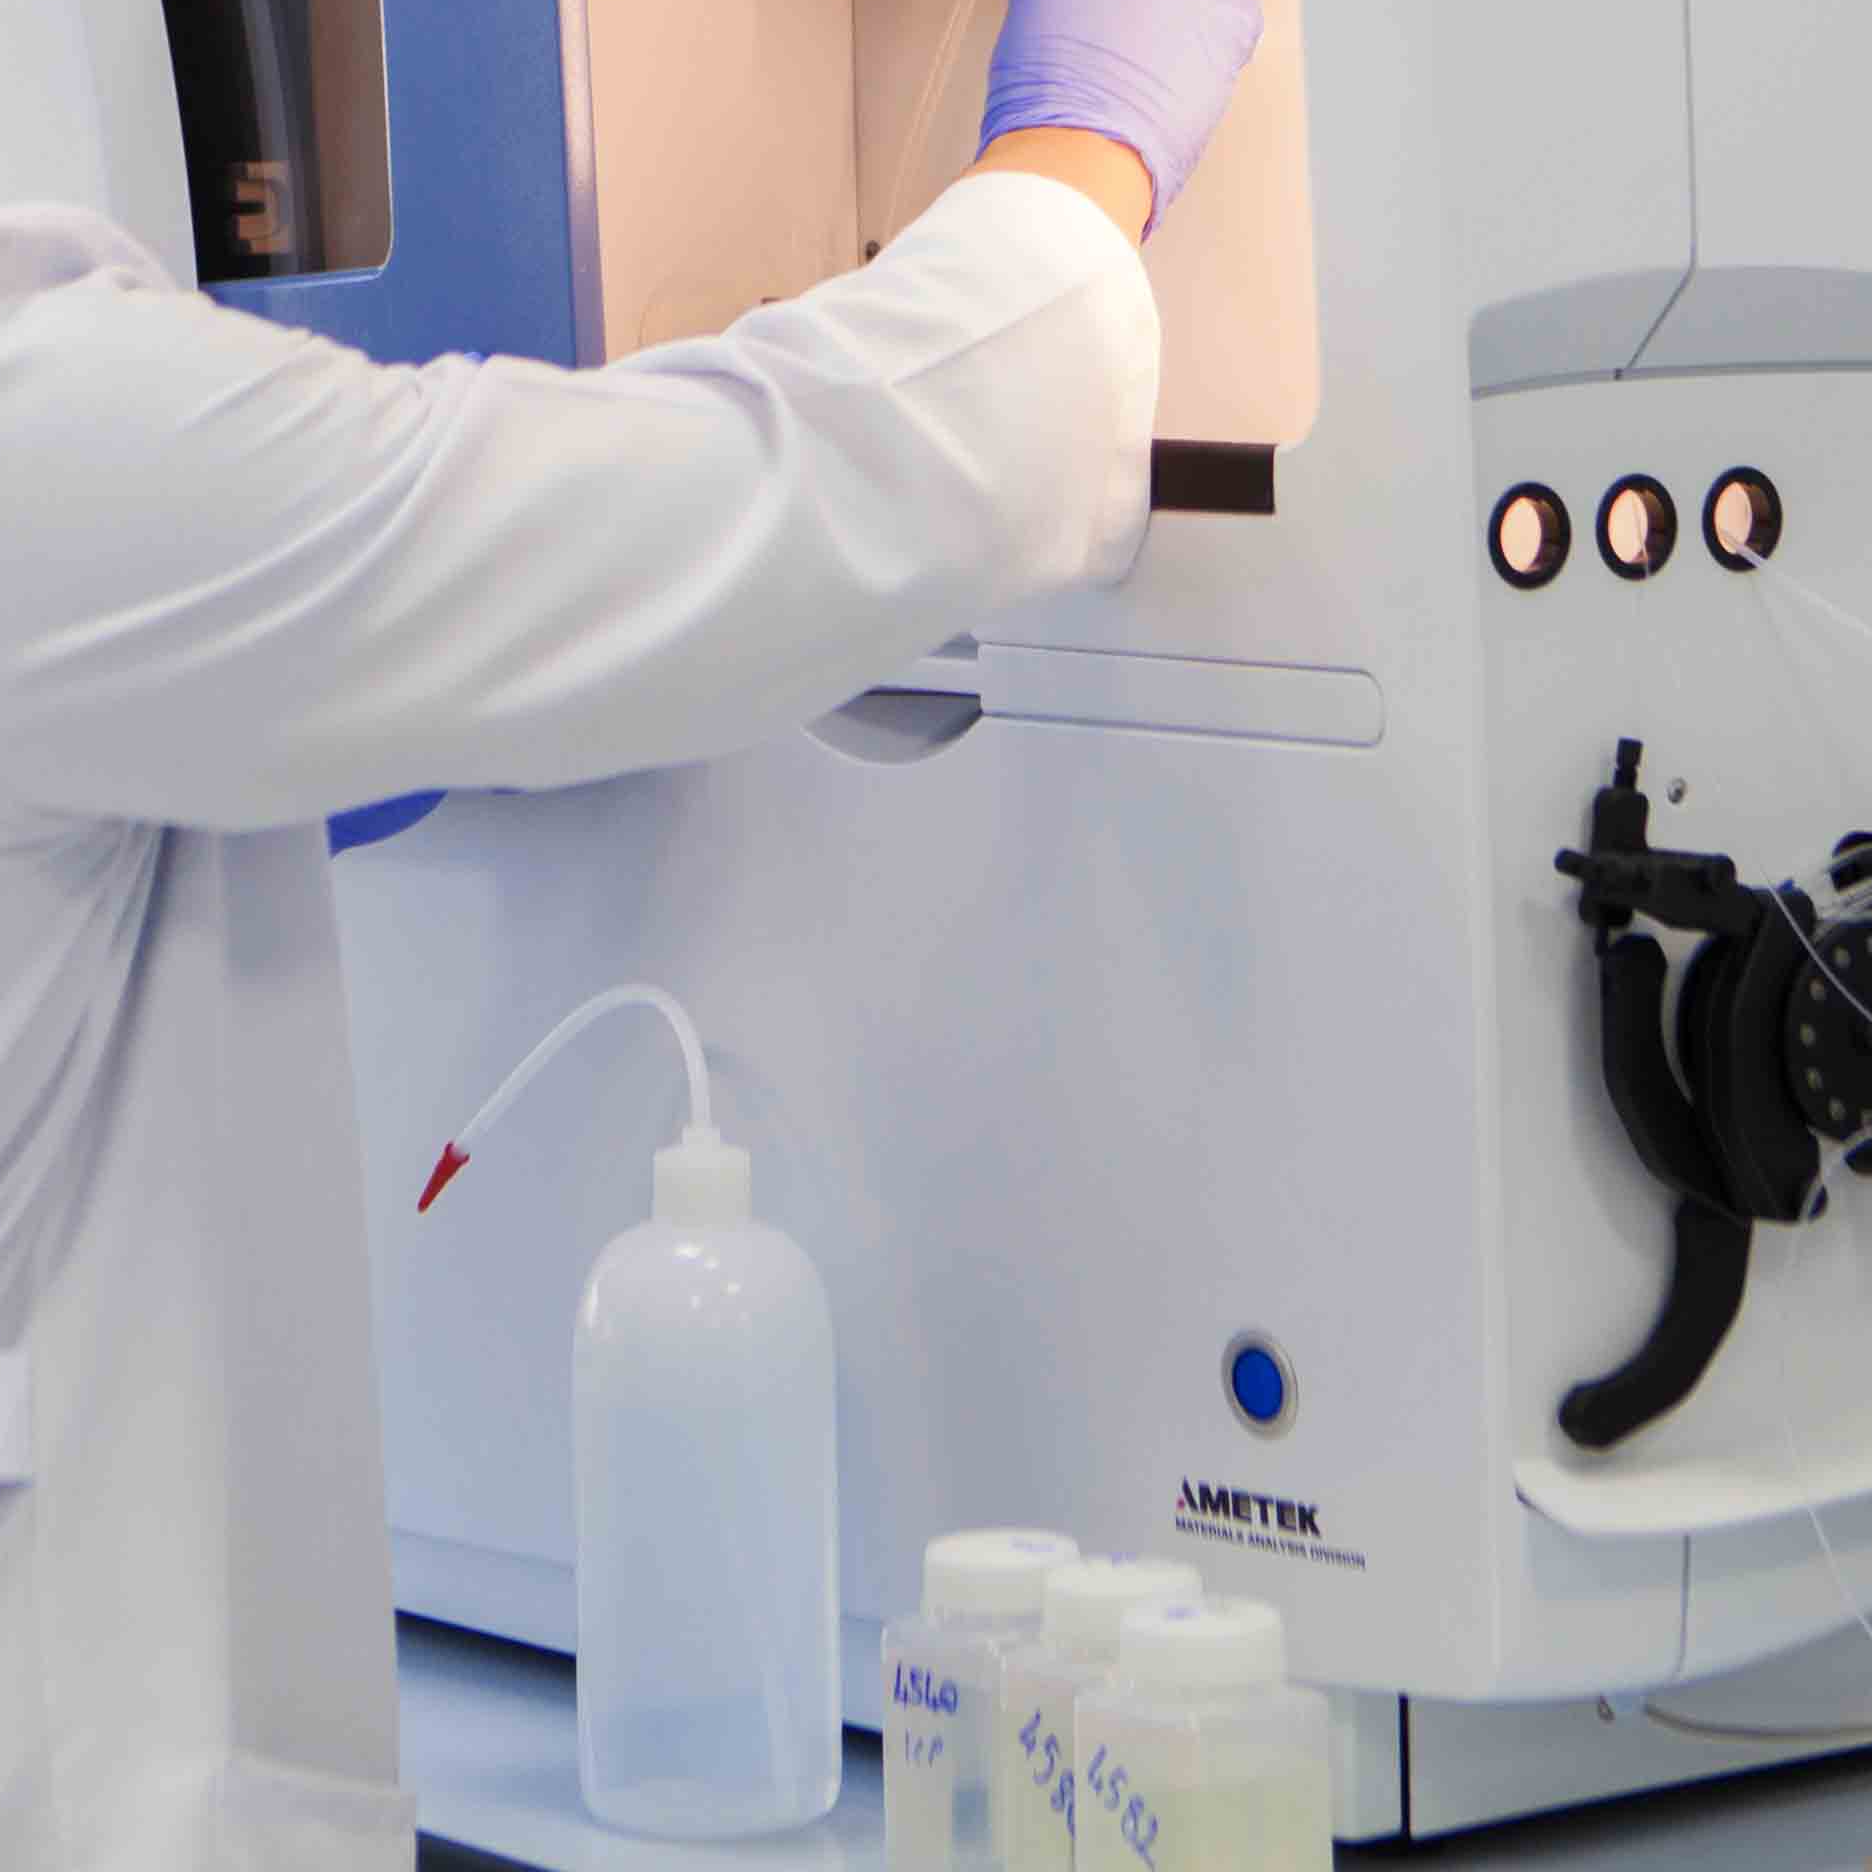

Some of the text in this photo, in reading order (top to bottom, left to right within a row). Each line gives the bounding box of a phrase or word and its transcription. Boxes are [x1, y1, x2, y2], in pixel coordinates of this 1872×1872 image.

[1177, 1475, 1321, 1539] AMETEK
[1175, 1517, 1367, 1572] MATERIALS ANALYSIS DIVISION
